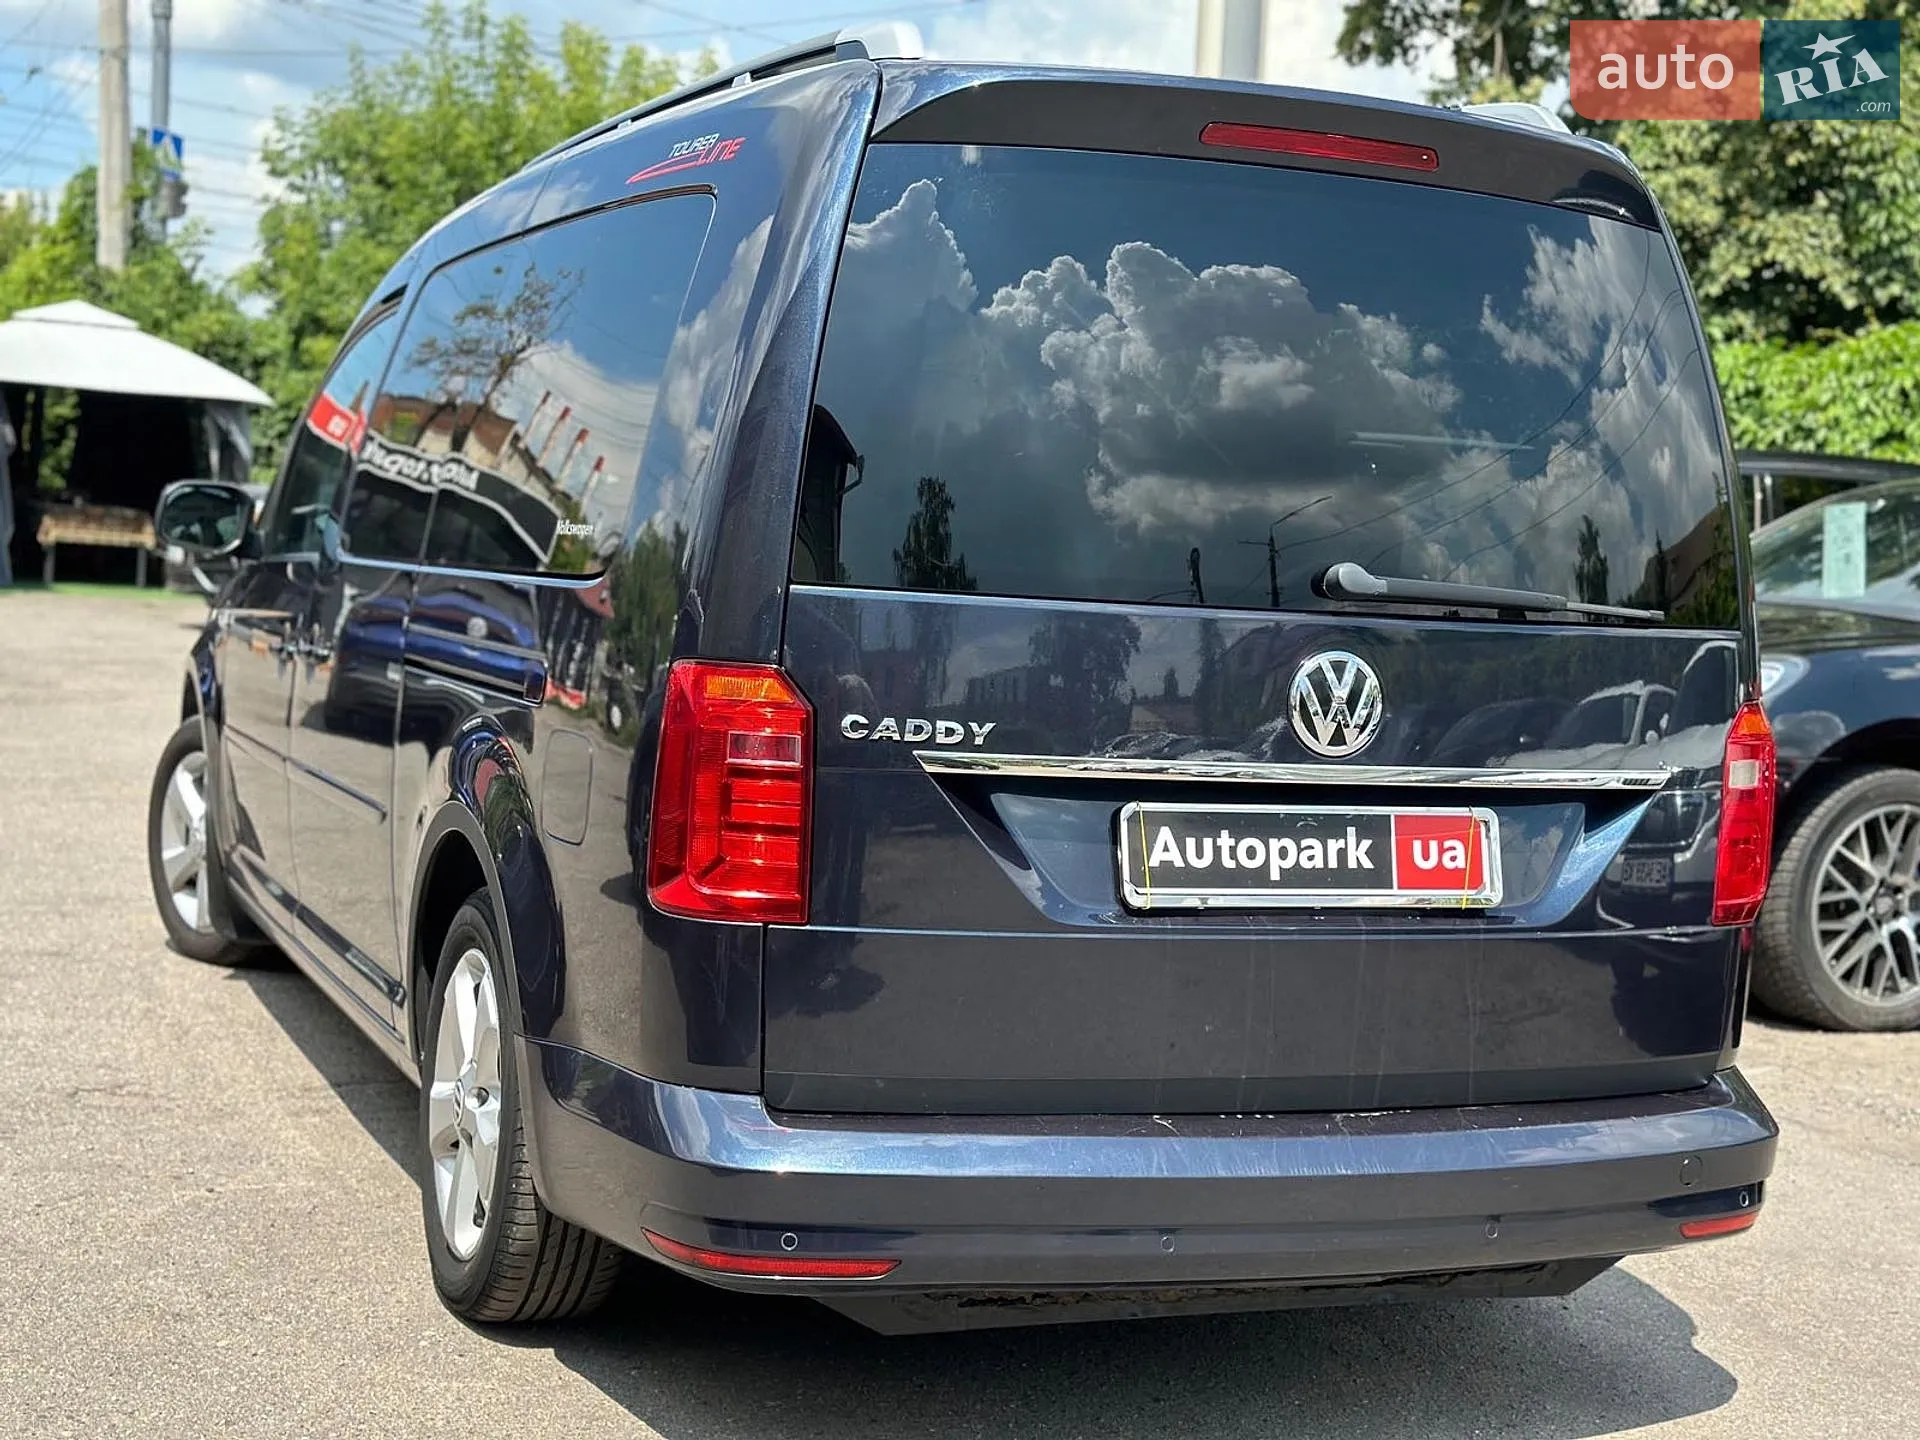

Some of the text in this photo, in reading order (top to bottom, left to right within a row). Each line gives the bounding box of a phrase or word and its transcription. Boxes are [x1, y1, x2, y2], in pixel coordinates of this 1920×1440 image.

[668, 132, 720, 159] TOURER
[840, 713, 996, 746] CADDY
[1148, 825, 1467, 881] Autopark ua
